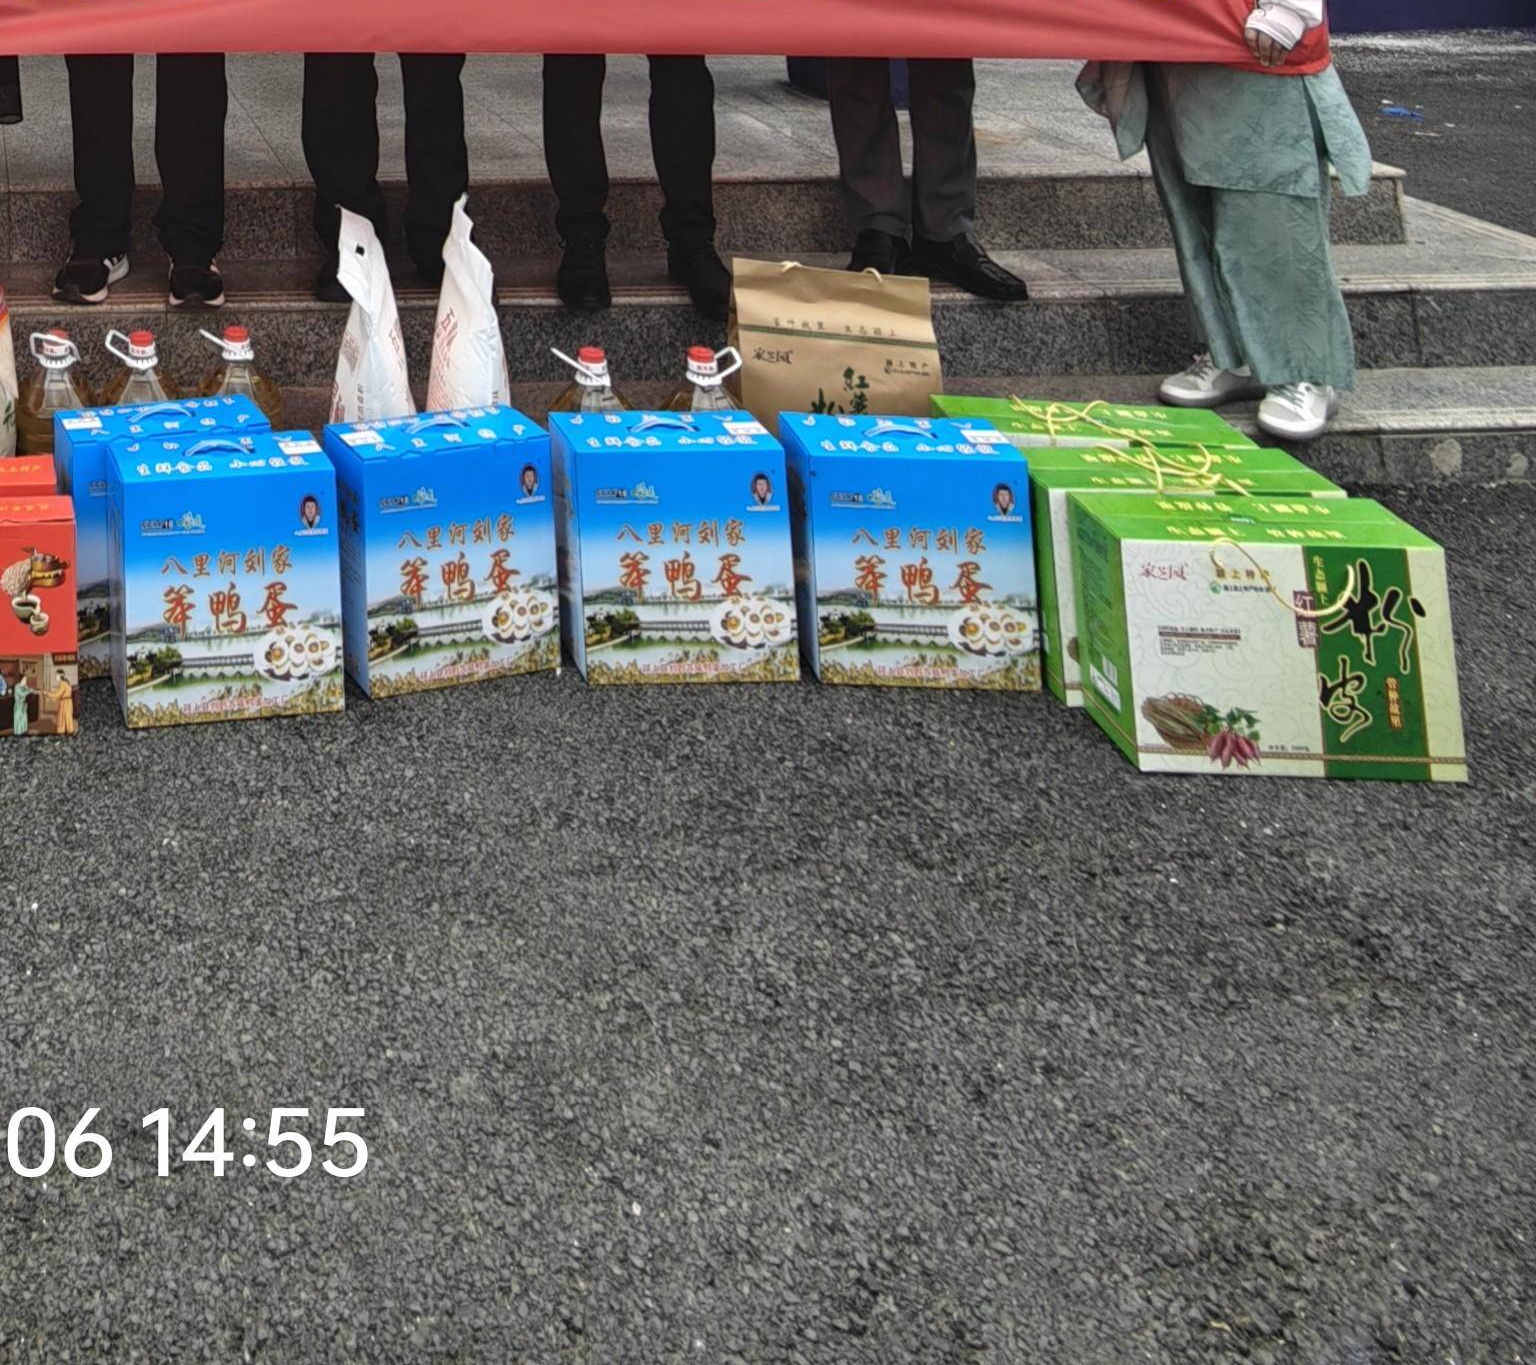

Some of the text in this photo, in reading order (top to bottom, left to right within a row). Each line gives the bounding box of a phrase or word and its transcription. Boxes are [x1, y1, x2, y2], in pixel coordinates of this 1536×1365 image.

[397, 514, 516, 550] 八里河刘家
[616, 519, 746, 547] 八里河刘家
[851, 527, 987, 555] 八里河刘家
[161, 544, 293, 578] 八里河刘家
[400, 548, 520, 606] 笨鸭蛋
[619, 551, 753, 605] 笨鸭蛋
[853, 554, 993, 607] 笨鸭蛋
[163, 581, 298, 641] 笨鸭蛋
